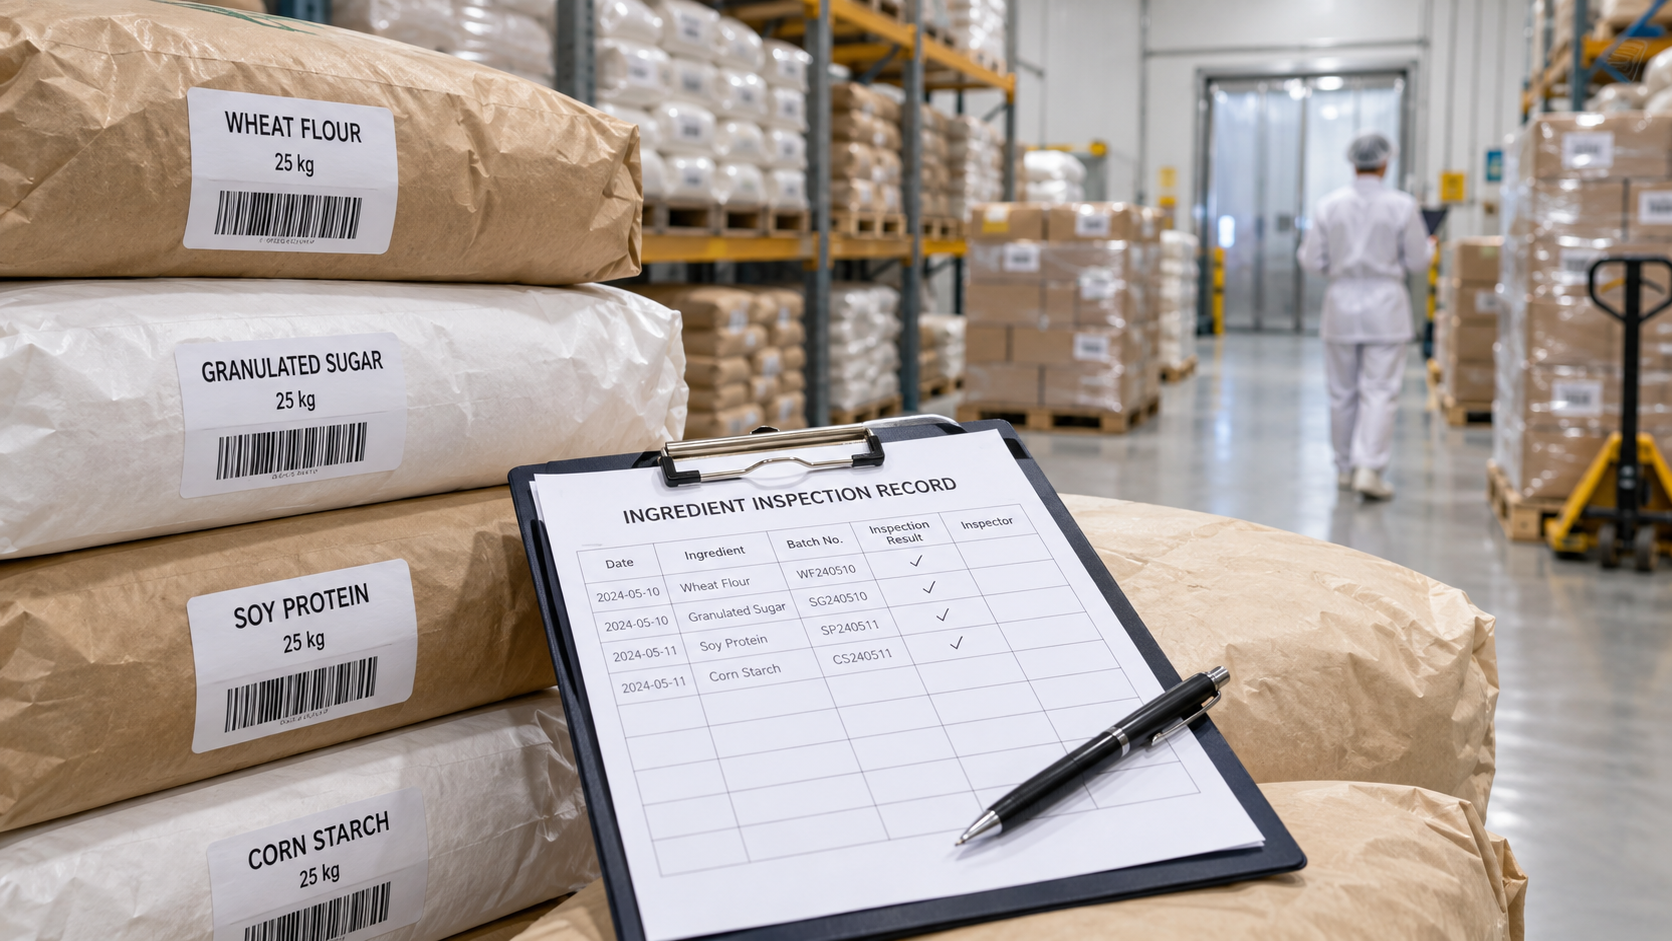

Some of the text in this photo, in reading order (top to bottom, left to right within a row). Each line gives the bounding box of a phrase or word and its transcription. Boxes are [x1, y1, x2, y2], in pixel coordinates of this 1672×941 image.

[225, 111, 362, 143] WHEAT FLOUR
[275, 152, 314, 177] 25 kg
[202, 350, 383, 382] GRANULATED SUGAR
[276, 390, 316, 411] 25 kg
[623, 477, 957, 525] INGREDIENT INSPECTION RECORD
[869, 520, 930, 535] Inspection
[960, 516, 1014, 530] Inspector
[786, 535, 844, 549] Batch No.
[886, 533, 924, 545] Result
[684, 545, 746, 562] Ingredient
[605, 558, 634, 569] Date
[796, 564, 856, 580] WF240510
[679, 577, 751, 593] Wheat Flour
[596, 586, 660, 603] 2024-05-10
[808, 591, 868, 607] SG240510
[233, 582, 370, 629] SOY PROTEIN
[688, 602, 787, 623] Granulated Sugar
[604, 615, 669, 632] 2024-05-10
[820, 619, 879, 636] SP240511
[283, 631, 325, 653] 25 kg
[699, 634, 768, 652] Soy Protein
[613, 645, 677, 663] 2024-05-11
[832, 648, 892, 665] CS240511
[709, 664, 782, 682] Corn Starch
[621, 676, 686, 694] 2024-05-11
[248, 810, 390, 870] CORN STARCH
[299, 863, 340, 888] 25 kg
